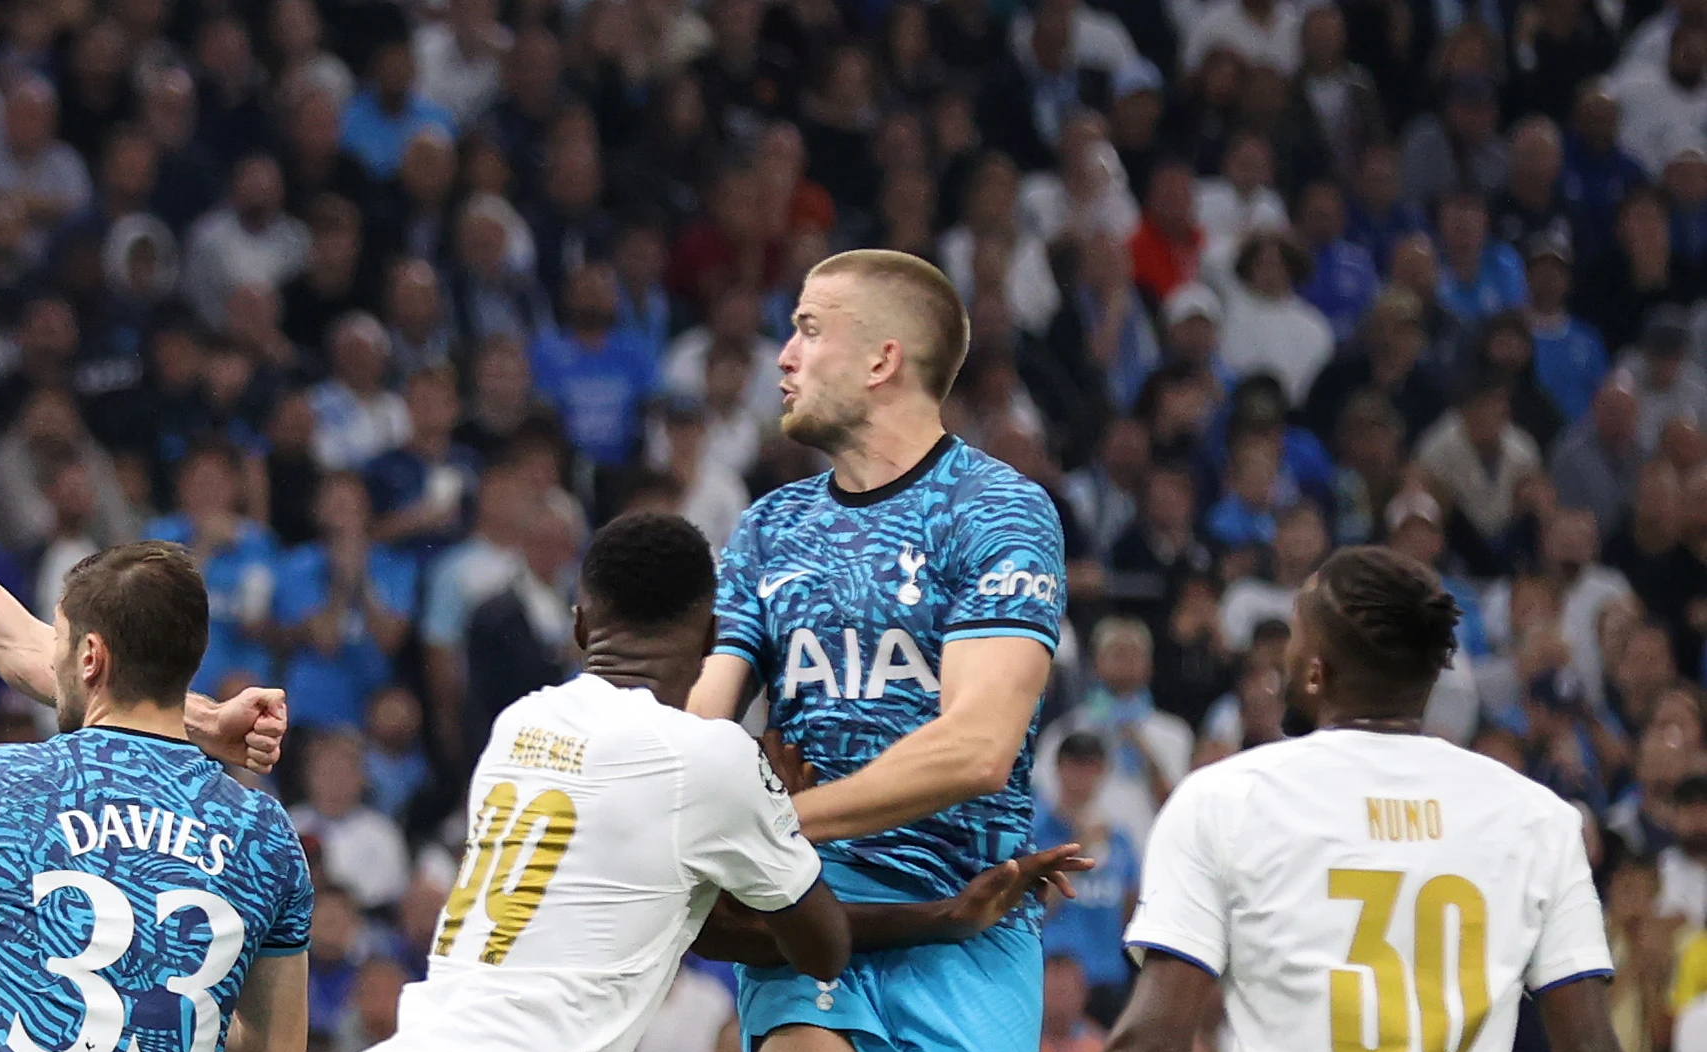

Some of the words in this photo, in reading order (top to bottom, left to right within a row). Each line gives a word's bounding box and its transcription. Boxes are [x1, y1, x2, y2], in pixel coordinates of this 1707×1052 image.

[781, 627, 941, 700] AIA
[57, 804, 234, 876] DAVIES
[1366, 796, 1443, 842] NUNO
